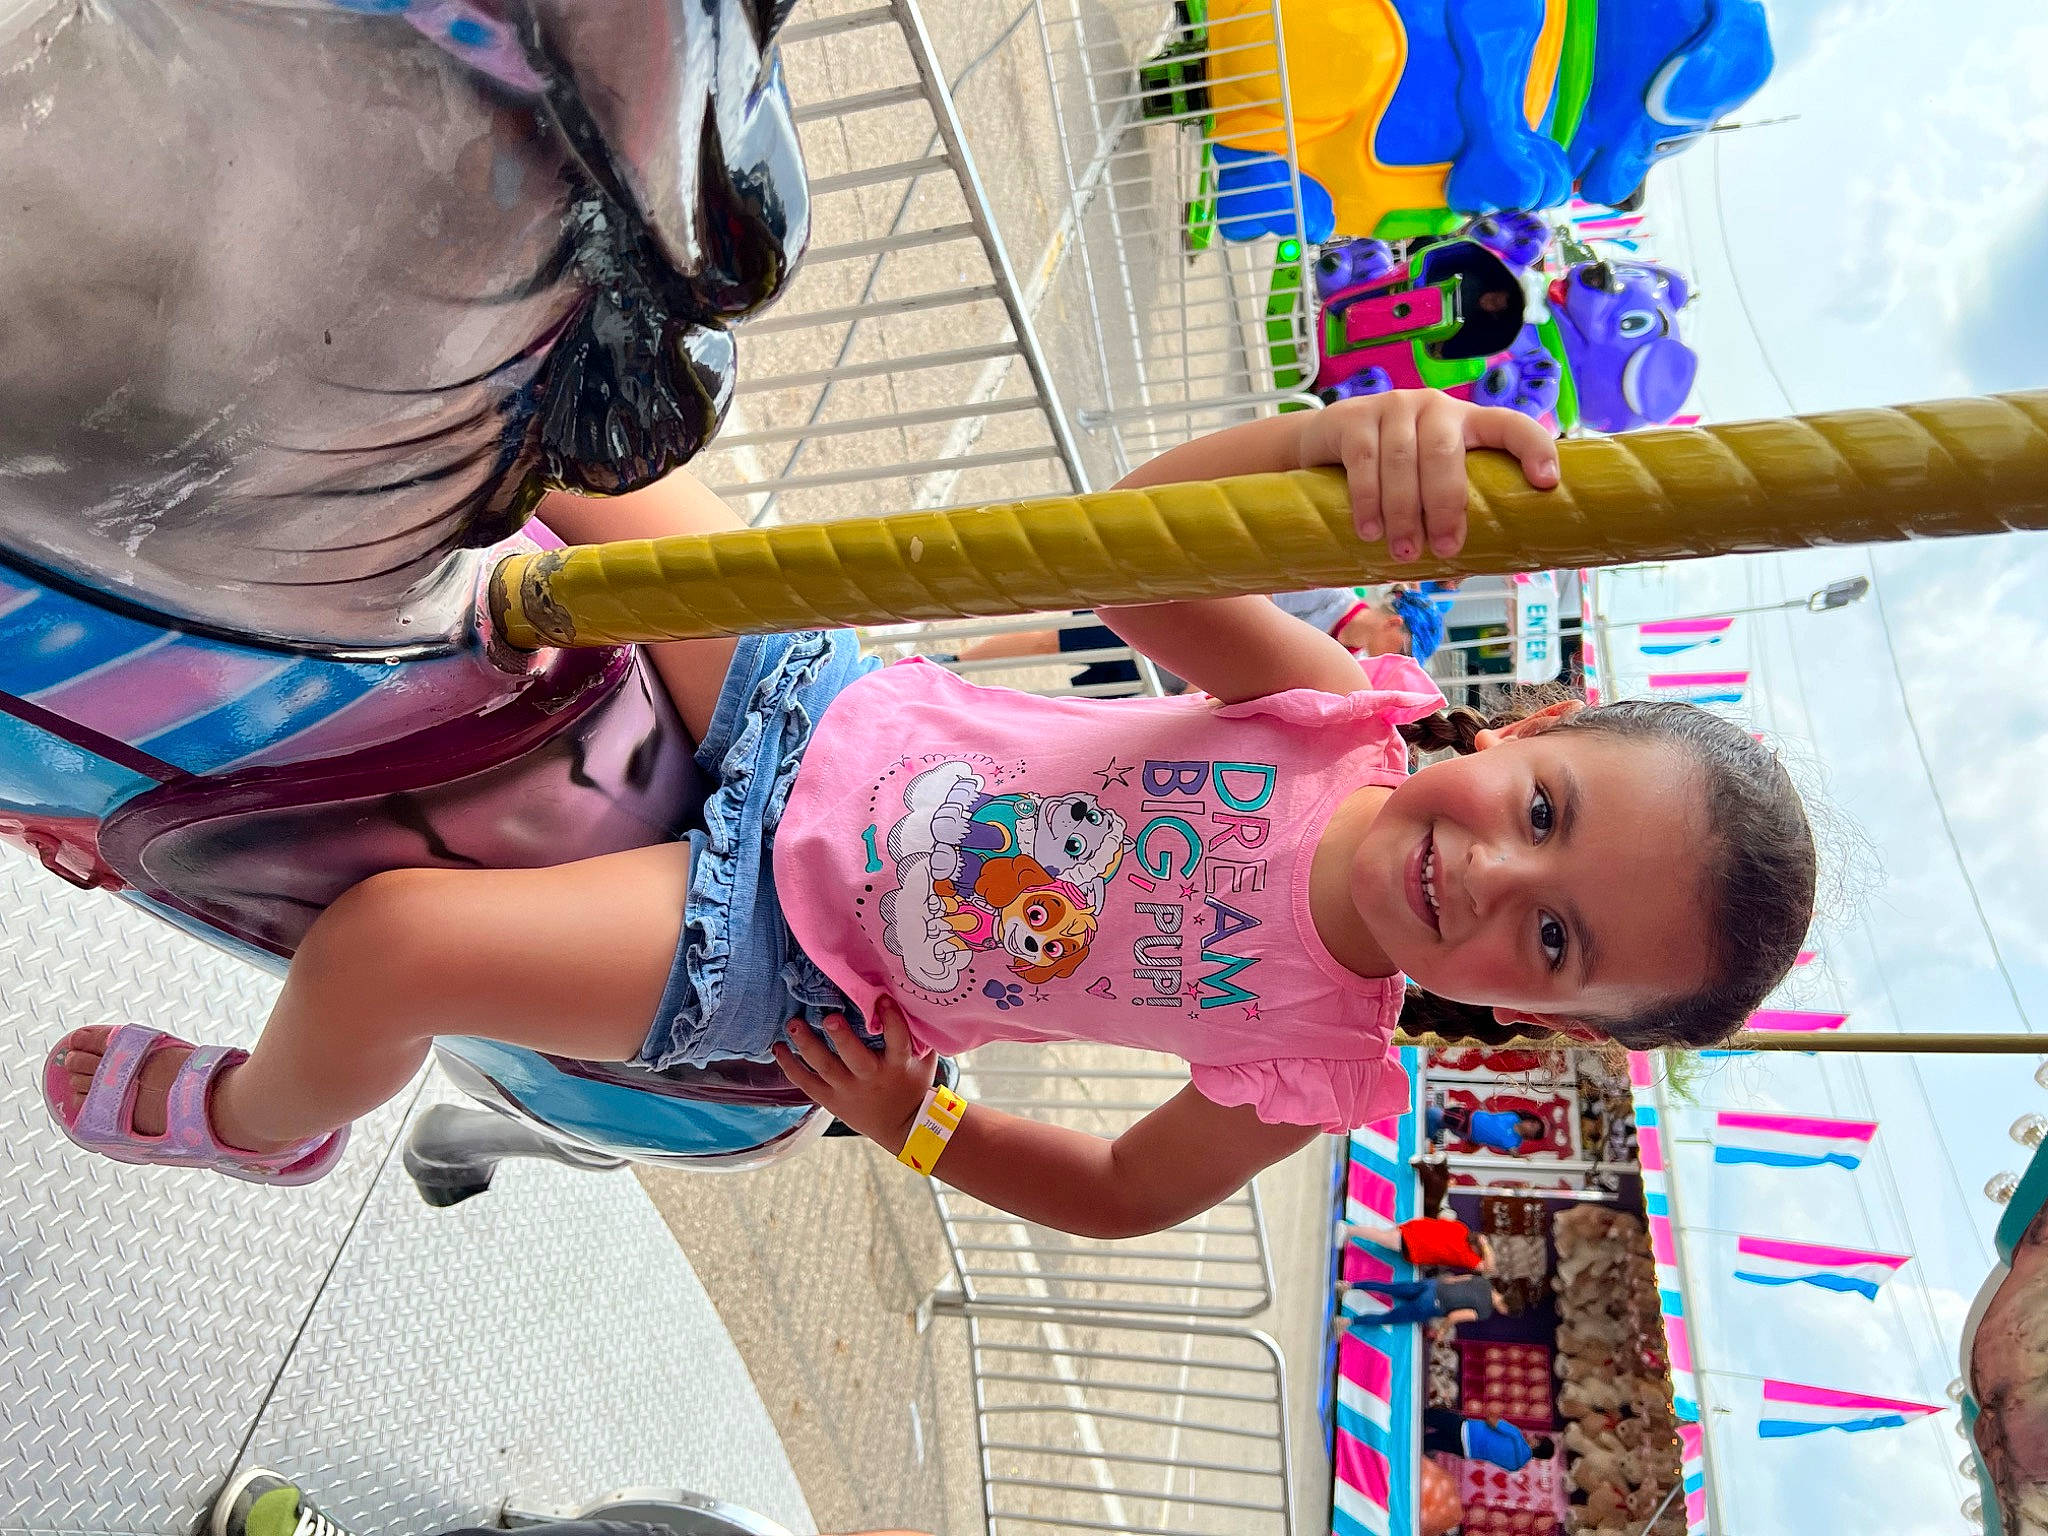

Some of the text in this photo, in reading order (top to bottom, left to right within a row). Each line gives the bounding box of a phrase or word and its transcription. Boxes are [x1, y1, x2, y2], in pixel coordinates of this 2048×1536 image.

[1527, 605, 1547, 663] ENTER
[1128, 760, 1209, 1007] BIG, PUP!
[1200, 761, 1277, 1009] DREAM
